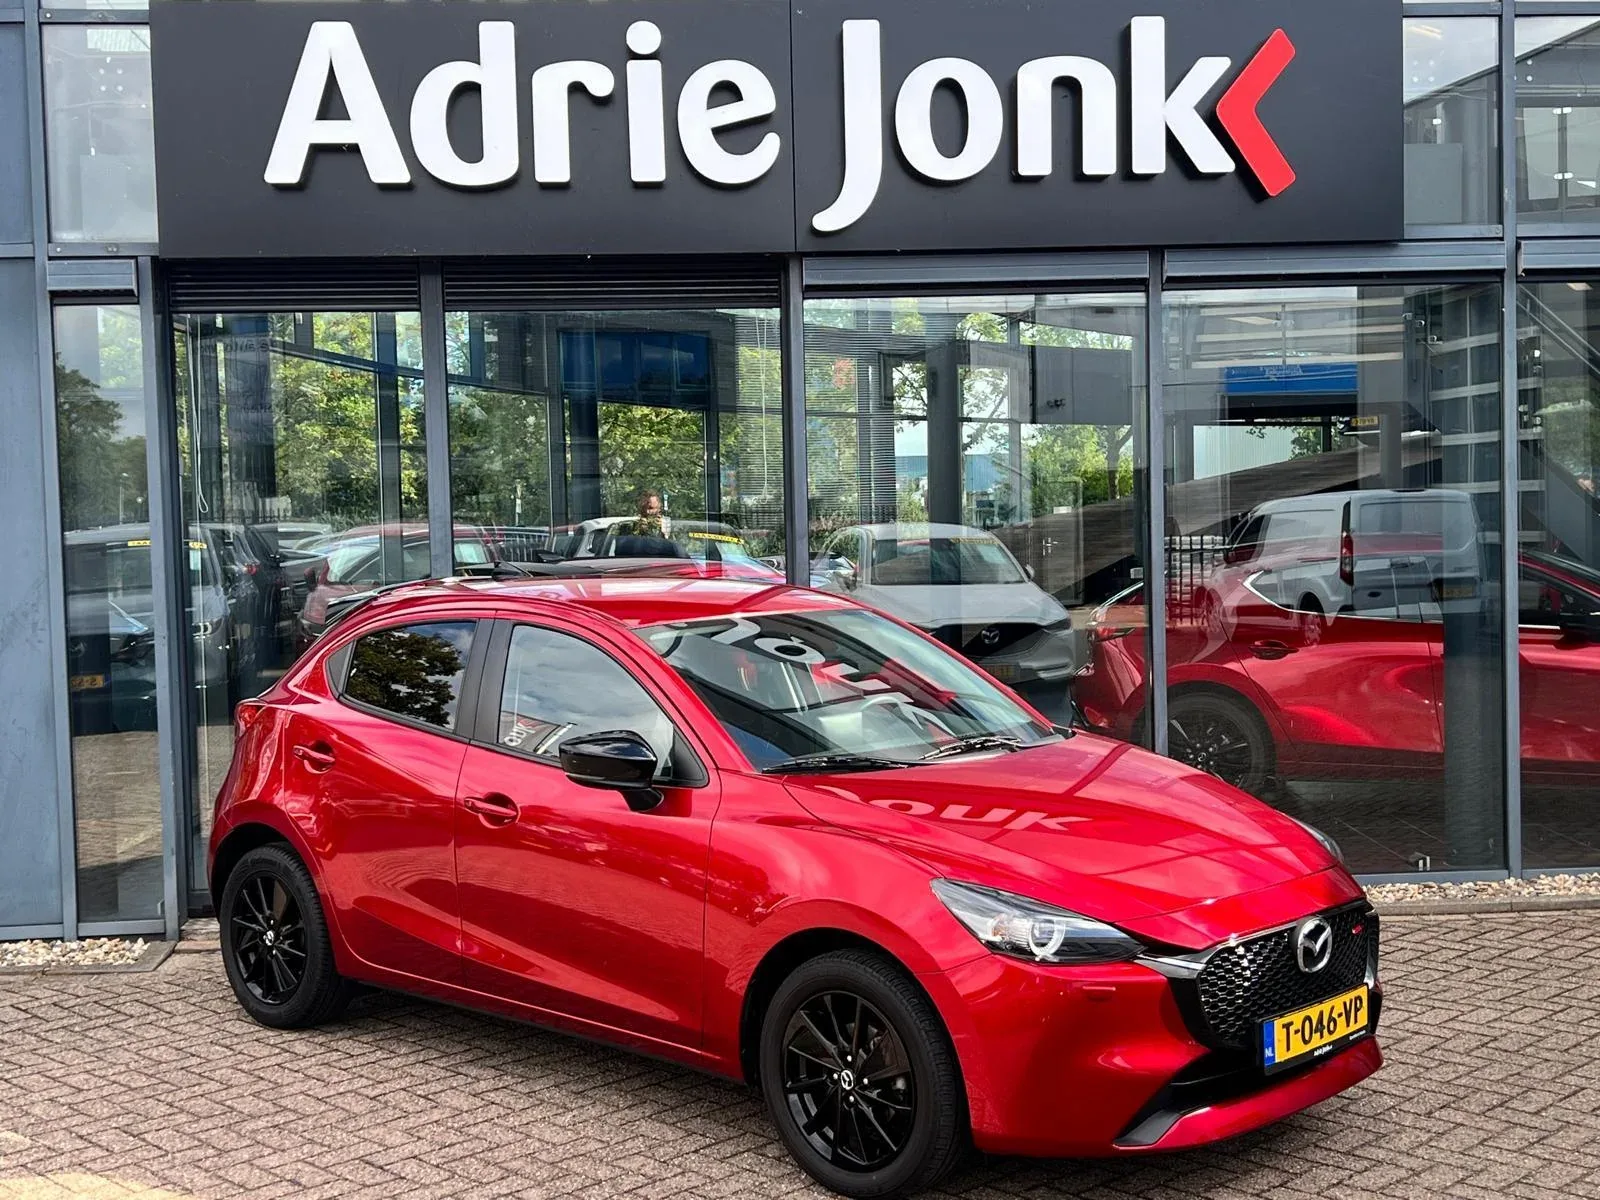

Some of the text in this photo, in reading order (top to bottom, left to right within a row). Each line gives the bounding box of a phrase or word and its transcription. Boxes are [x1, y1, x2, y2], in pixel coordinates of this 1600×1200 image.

[264, 15, 1236, 233] Adrie Jonk
[1264, 1047, 1274, 1058] NL
[1281, 995, 1364, 1053] T-046-VP
